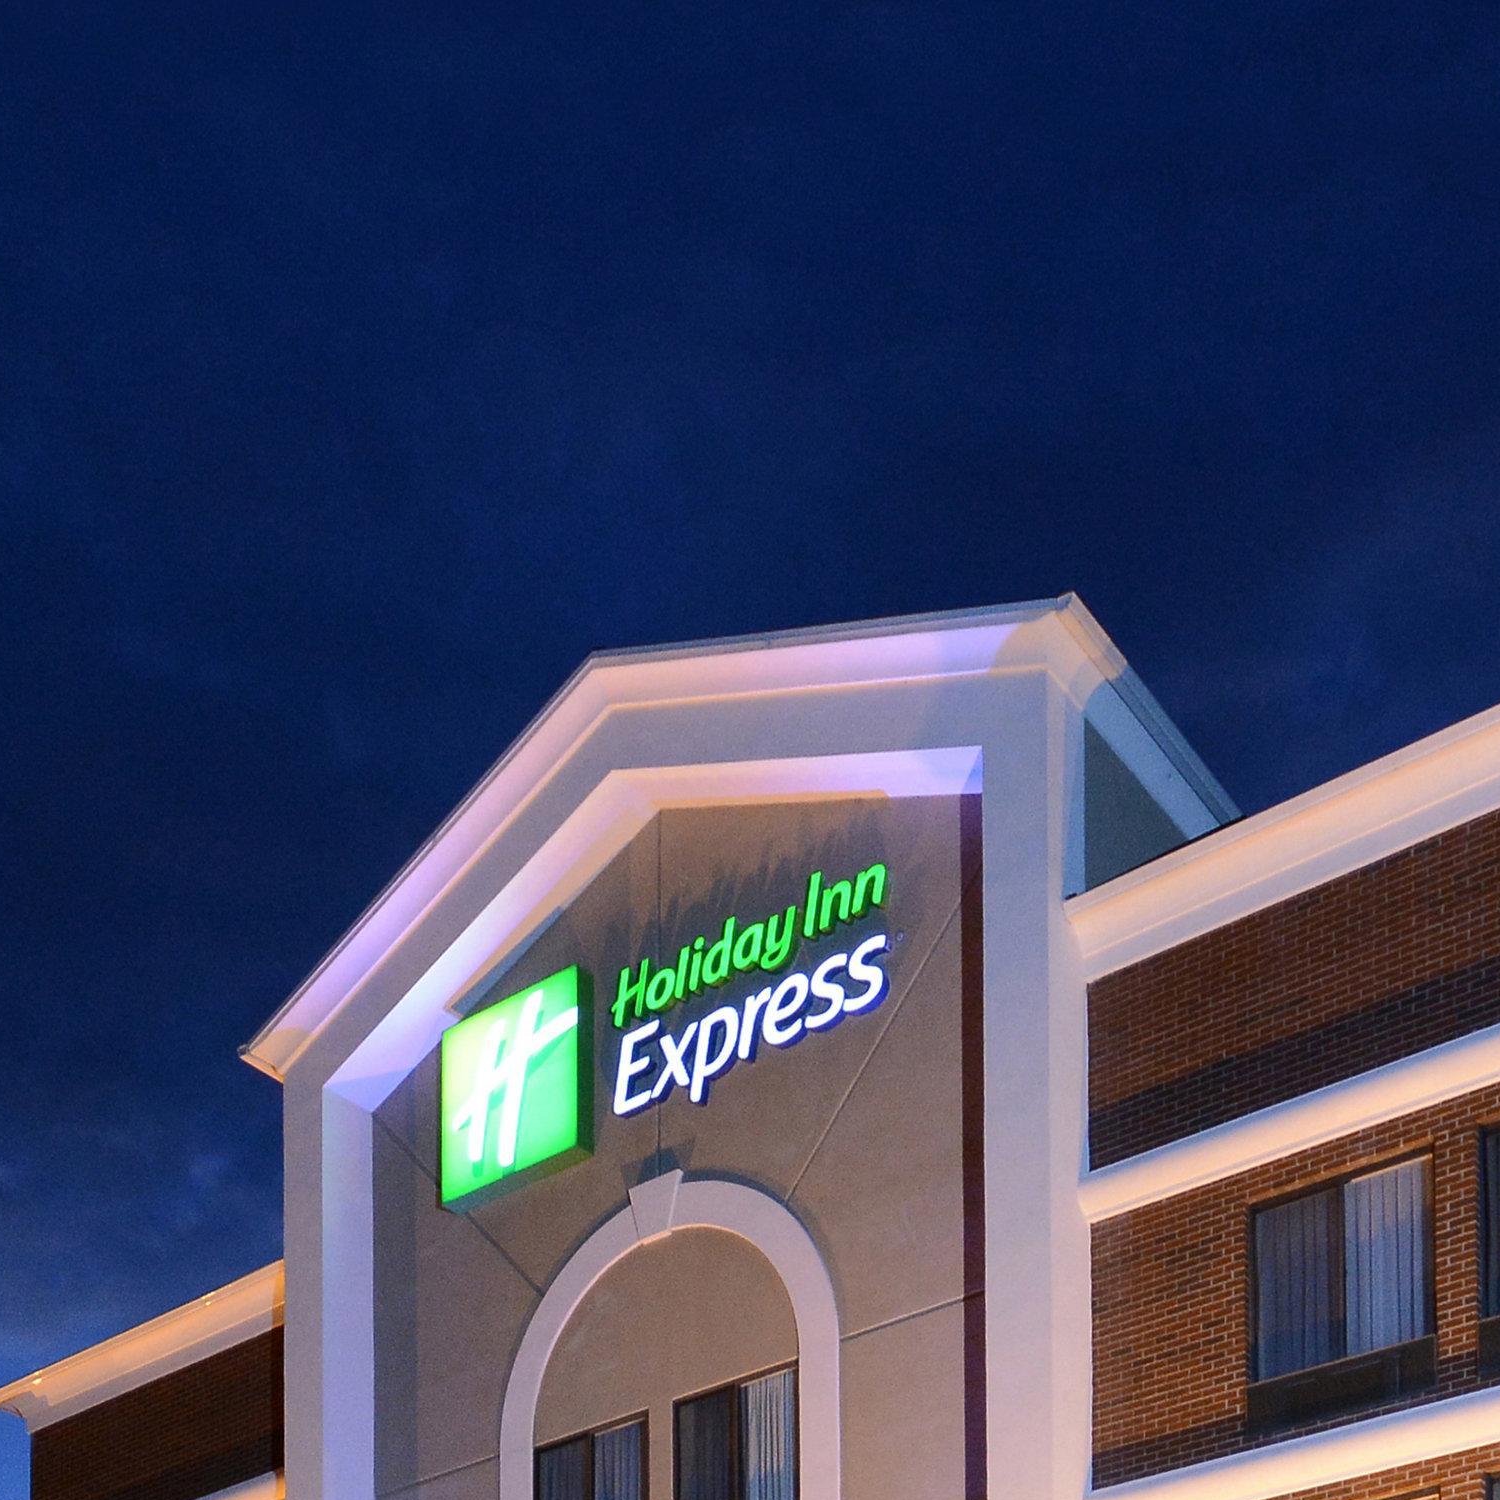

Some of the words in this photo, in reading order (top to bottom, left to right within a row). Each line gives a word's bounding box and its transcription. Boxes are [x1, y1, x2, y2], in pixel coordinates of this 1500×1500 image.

[611, 905, 797, 1029] Holiday
[803, 863, 887, 939] Inn
[612, 933, 890, 1116] Express
